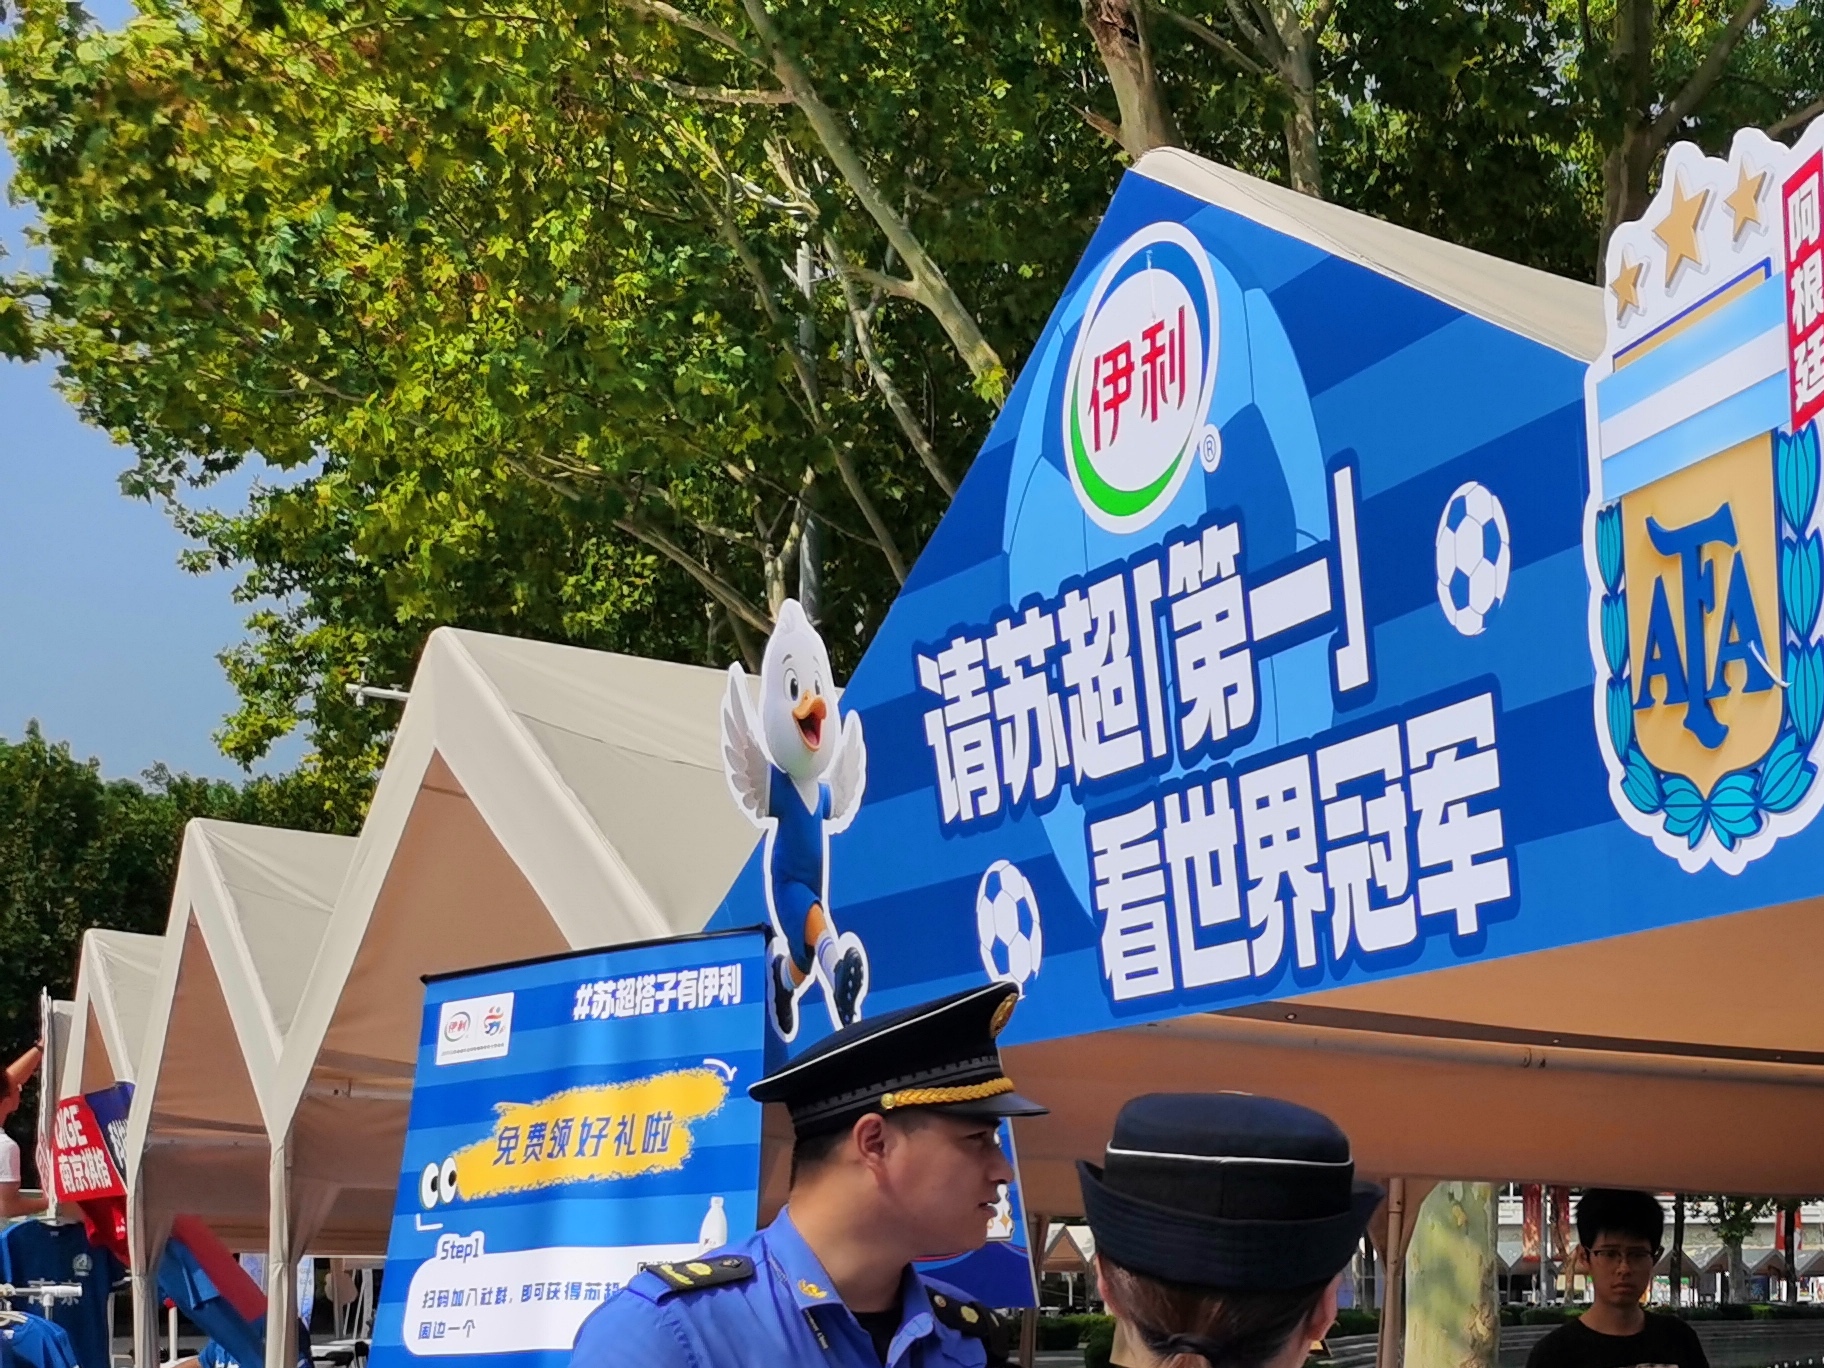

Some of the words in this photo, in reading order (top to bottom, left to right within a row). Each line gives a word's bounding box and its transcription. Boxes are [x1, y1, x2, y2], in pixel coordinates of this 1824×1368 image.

[1087, 305, 1190, 452] 伊利
[1089, 693, 1513, 1001] 看世界冠军
[572, 963, 742, 1021] #苏超搭子有伊利
[448, 1019, 467, 1033] 伊利
[492, 1110, 675, 1167] 免费领好礼啦
[440, 1238, 480, 1262] Step1
[418, 1319, 476, 1340] 周边一个
